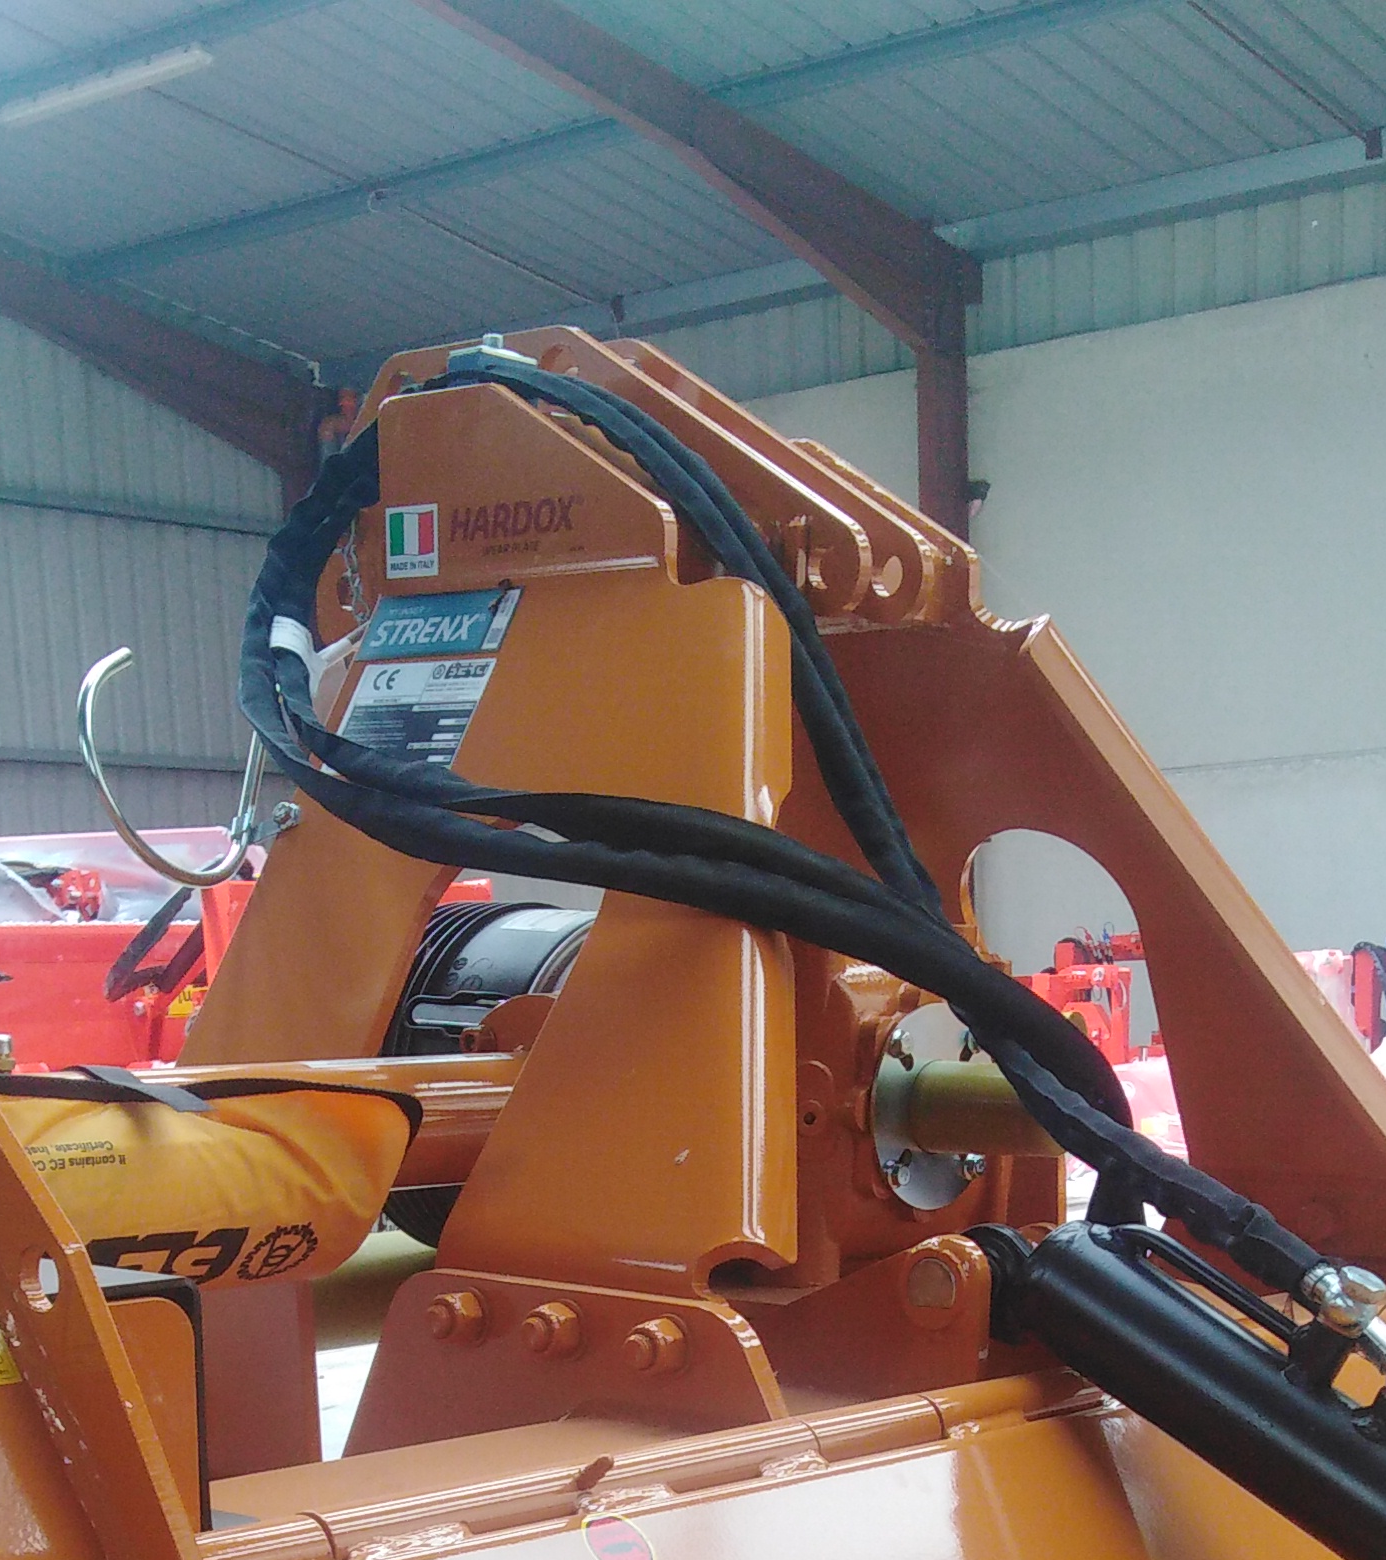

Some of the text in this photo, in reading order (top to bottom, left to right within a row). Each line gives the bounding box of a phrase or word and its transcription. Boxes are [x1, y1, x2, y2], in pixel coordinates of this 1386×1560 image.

[390, 560, 435, 571] MADE IN ITALY
[373, 668, 401, 691] CE
[49, 1157, 66, 1171] EC
[68, 1154, 116, 1169] contains
